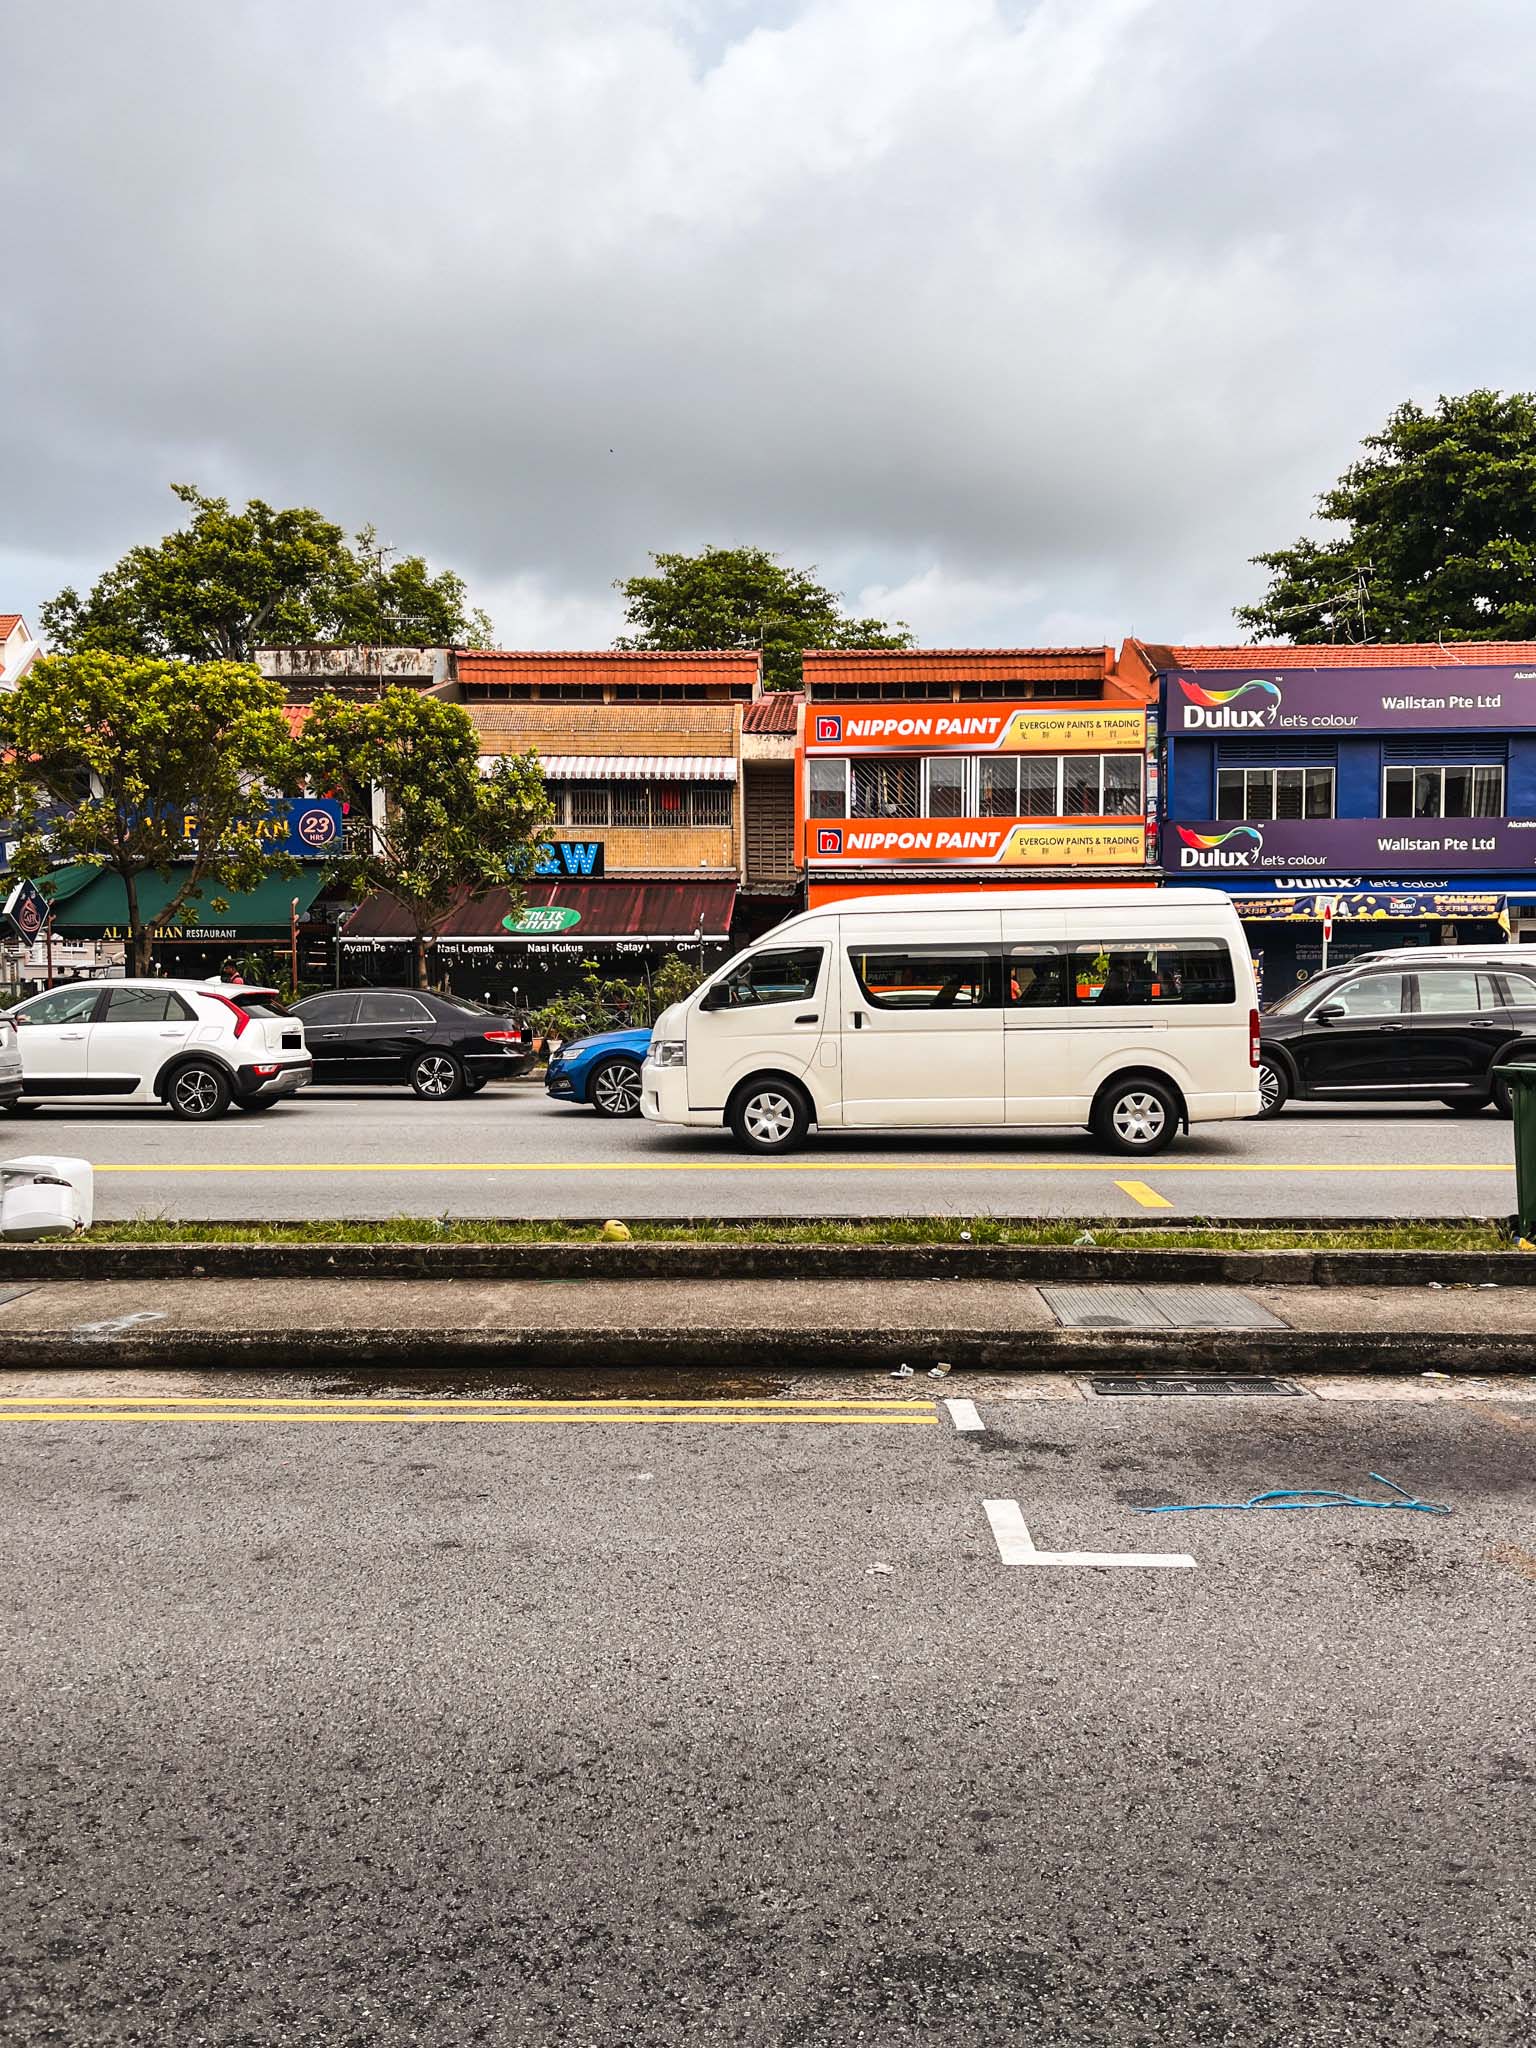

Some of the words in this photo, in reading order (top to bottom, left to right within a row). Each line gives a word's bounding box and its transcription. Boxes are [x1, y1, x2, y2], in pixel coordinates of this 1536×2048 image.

[1382, 696, 1445, 710] Wallstan
[1449, 696, 1474, 709] Pte
[1478, 694, 1501, 708] Ltd
[1184, 705, 1266, 728] Dulux
[1280, 715, 1308, 727] let's
[1311, 714, 1359, 727] colour
[846, 718, 932, 737] NIPPON
[935, 717, 1001, 736] PAINT
[1019, 721, 1065, 730] EVERGLOW
[1067, 720, 1094, 729] PAINTS
[1104, 719, 1140, 728] TRADING
[303, 817, 330, 833] 23
[847, 832, 933, 849] NIPPON
[936, 831, 1001, 848] PAINT
[1019, 837, 1065, 846] EVERGLOW
[1066, 837, 1093, 845] PAINTS
[1095, 837, 1101, 845] &
[1103, 836, 1139, 845] TRADING
[1378, 838, 1440, 851] Wallstan
[1444, 838, 1468, 850] Pte
[1472, 837, 1496, 850] Ltd
[1180, 847, 1250, 867] Dulux
[1261, 855, 1286, 866] let's
[1288, 855, 1327, 866] colour
[1369, 880, 1399, 888] let's
[1402, 880, 1449, 889] colour
[103, 927, 121, 938] AL
[186, 929, 237, 938] RESTAURANT
[343, 943, 371, 954] Ayam
[437, 944, 459, 953] Nasi
[462, 944, 495, 953] Lemak
[527, 943, 549, 953] Nasi
[552, 943, 584, 953] Kukus
[616, 942, 644, 954] Satay
